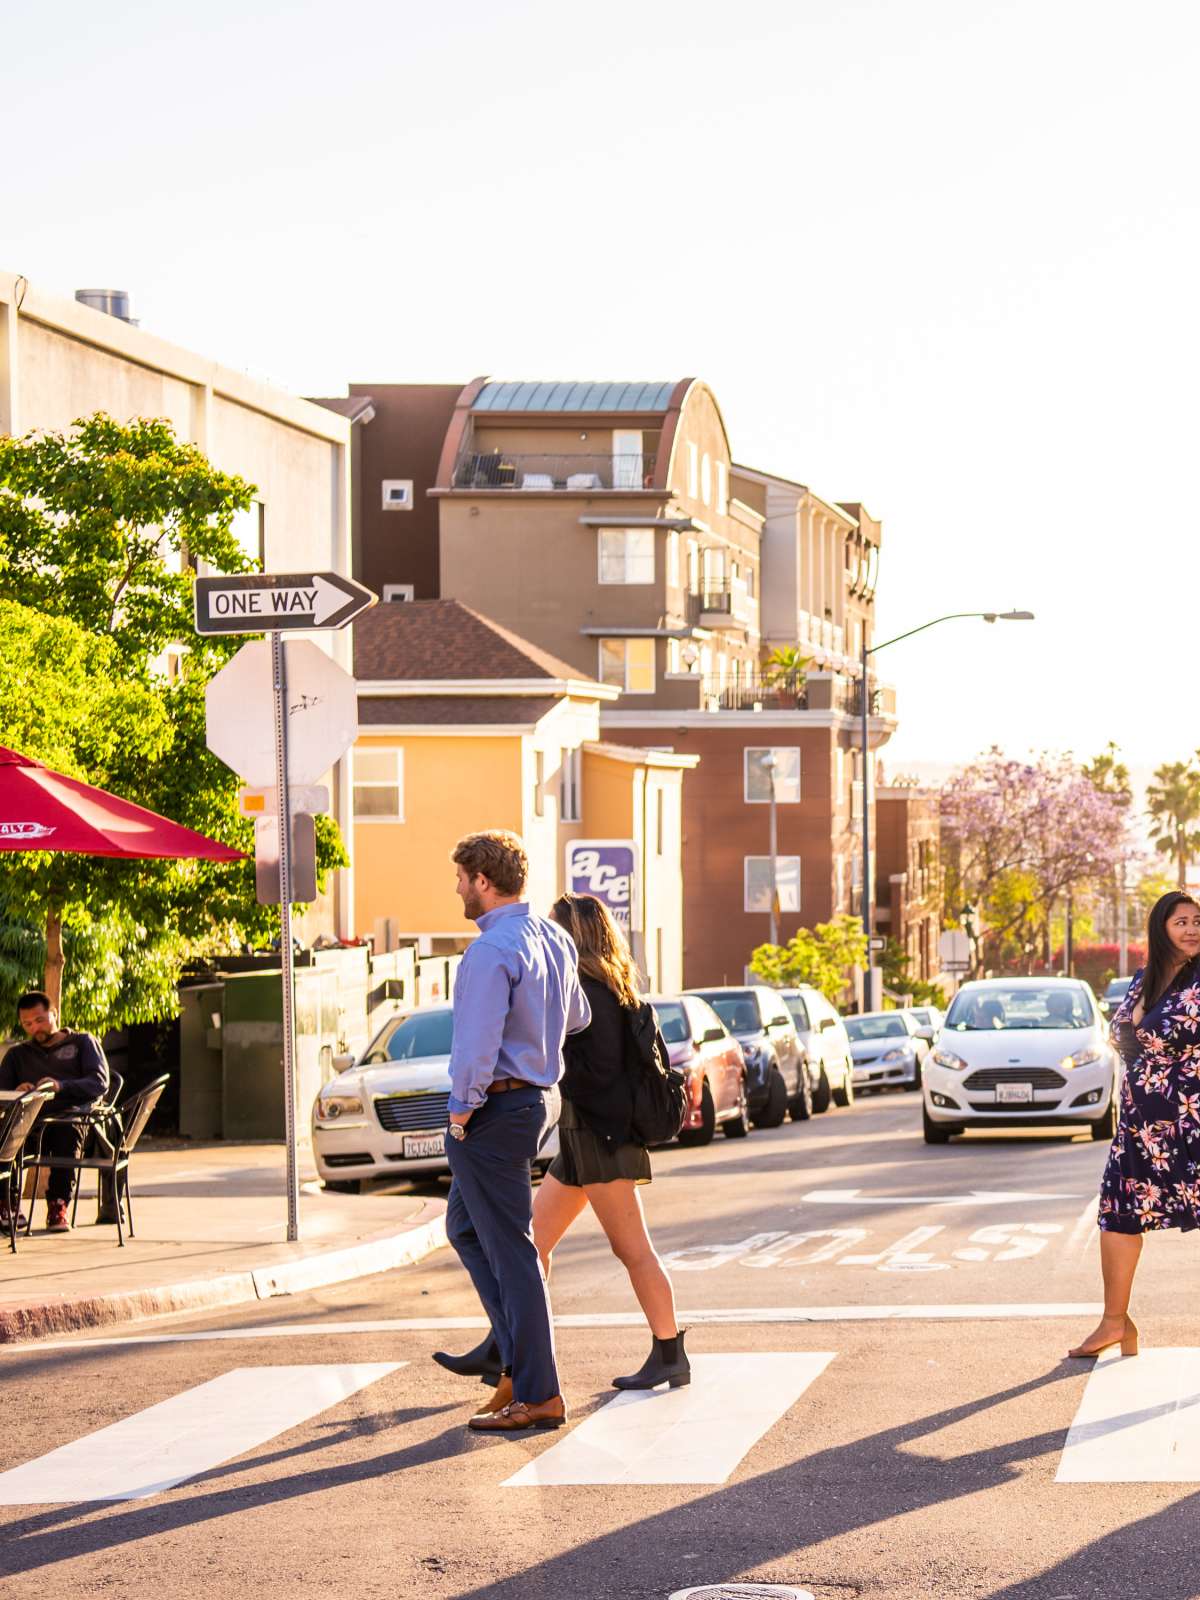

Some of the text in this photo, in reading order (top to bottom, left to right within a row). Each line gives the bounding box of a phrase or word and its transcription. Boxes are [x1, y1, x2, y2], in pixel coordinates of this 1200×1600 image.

[215, 590, 319, 614] ONE WAY
[571, 850, 630, 903] ace
[659, 1223, 1064, 1272] STOP
